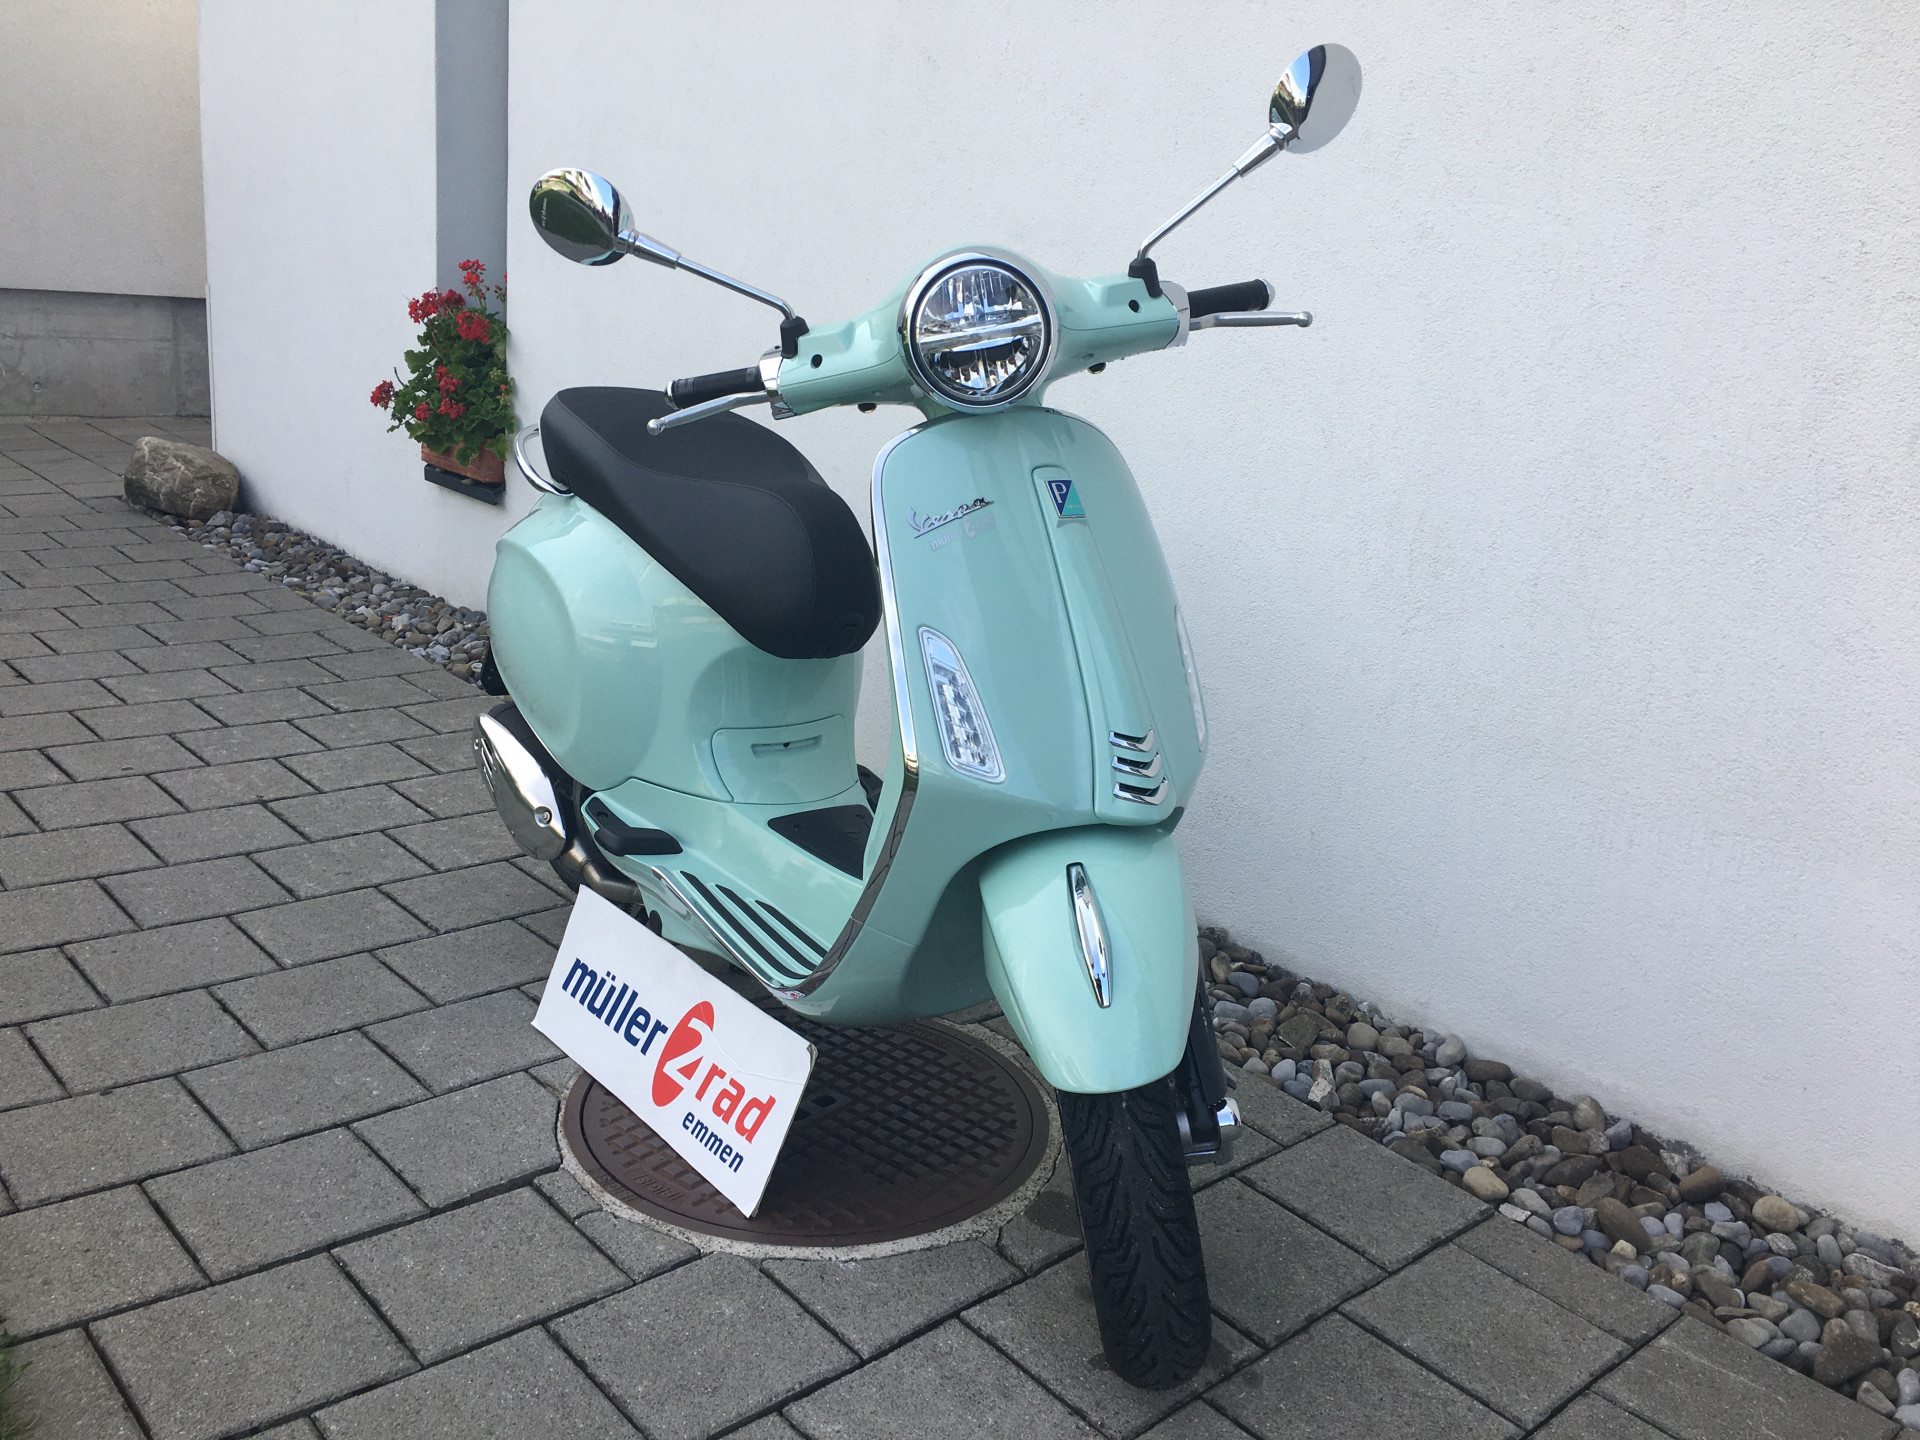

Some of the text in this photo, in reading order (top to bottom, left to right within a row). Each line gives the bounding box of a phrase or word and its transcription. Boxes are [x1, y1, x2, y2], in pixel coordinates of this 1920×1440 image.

[906, 497, 995, 539] Vespa
[1051, 482, 1067, 504] P
[561, 957, 669, 1056] müller
[682, 1111, 744, 1173] emmen
